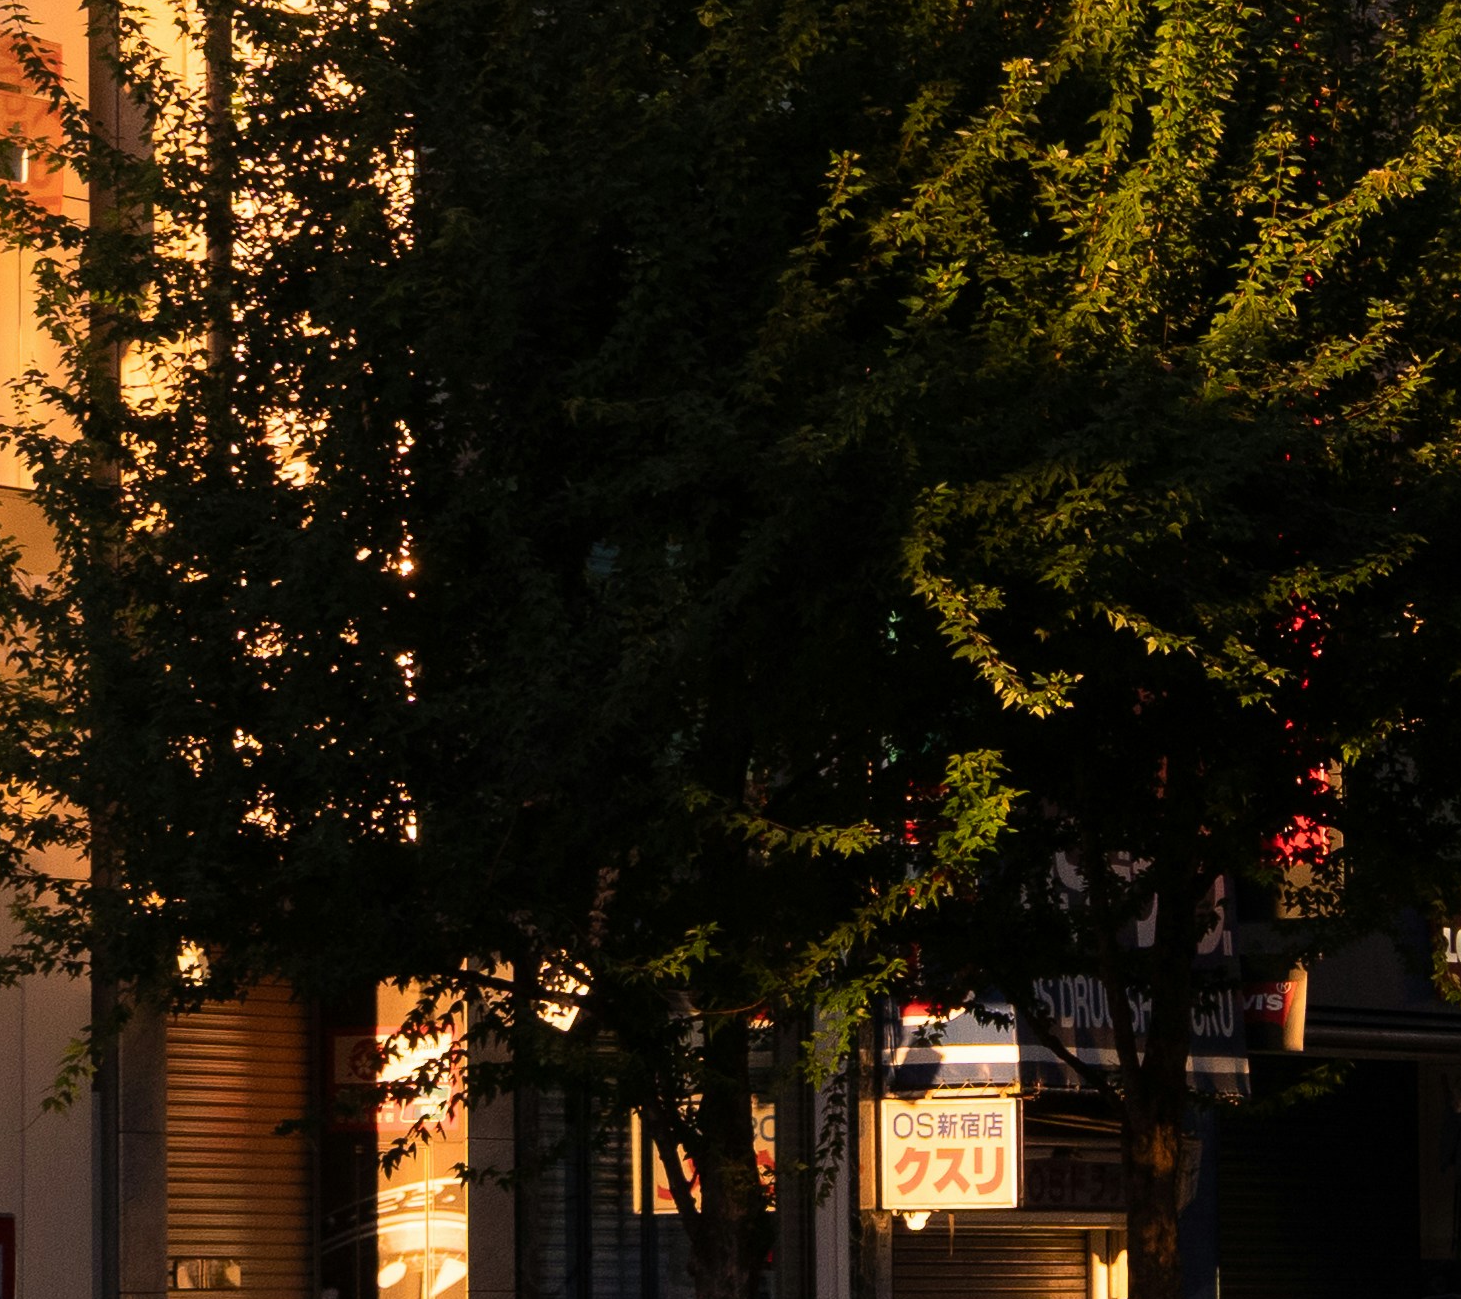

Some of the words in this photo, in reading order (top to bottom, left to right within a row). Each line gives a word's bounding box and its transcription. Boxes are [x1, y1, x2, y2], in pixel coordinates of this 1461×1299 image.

[892, 1111, 1005, 1140] OS新宿店
[893, 1145, 1007, 1196] クスリ
